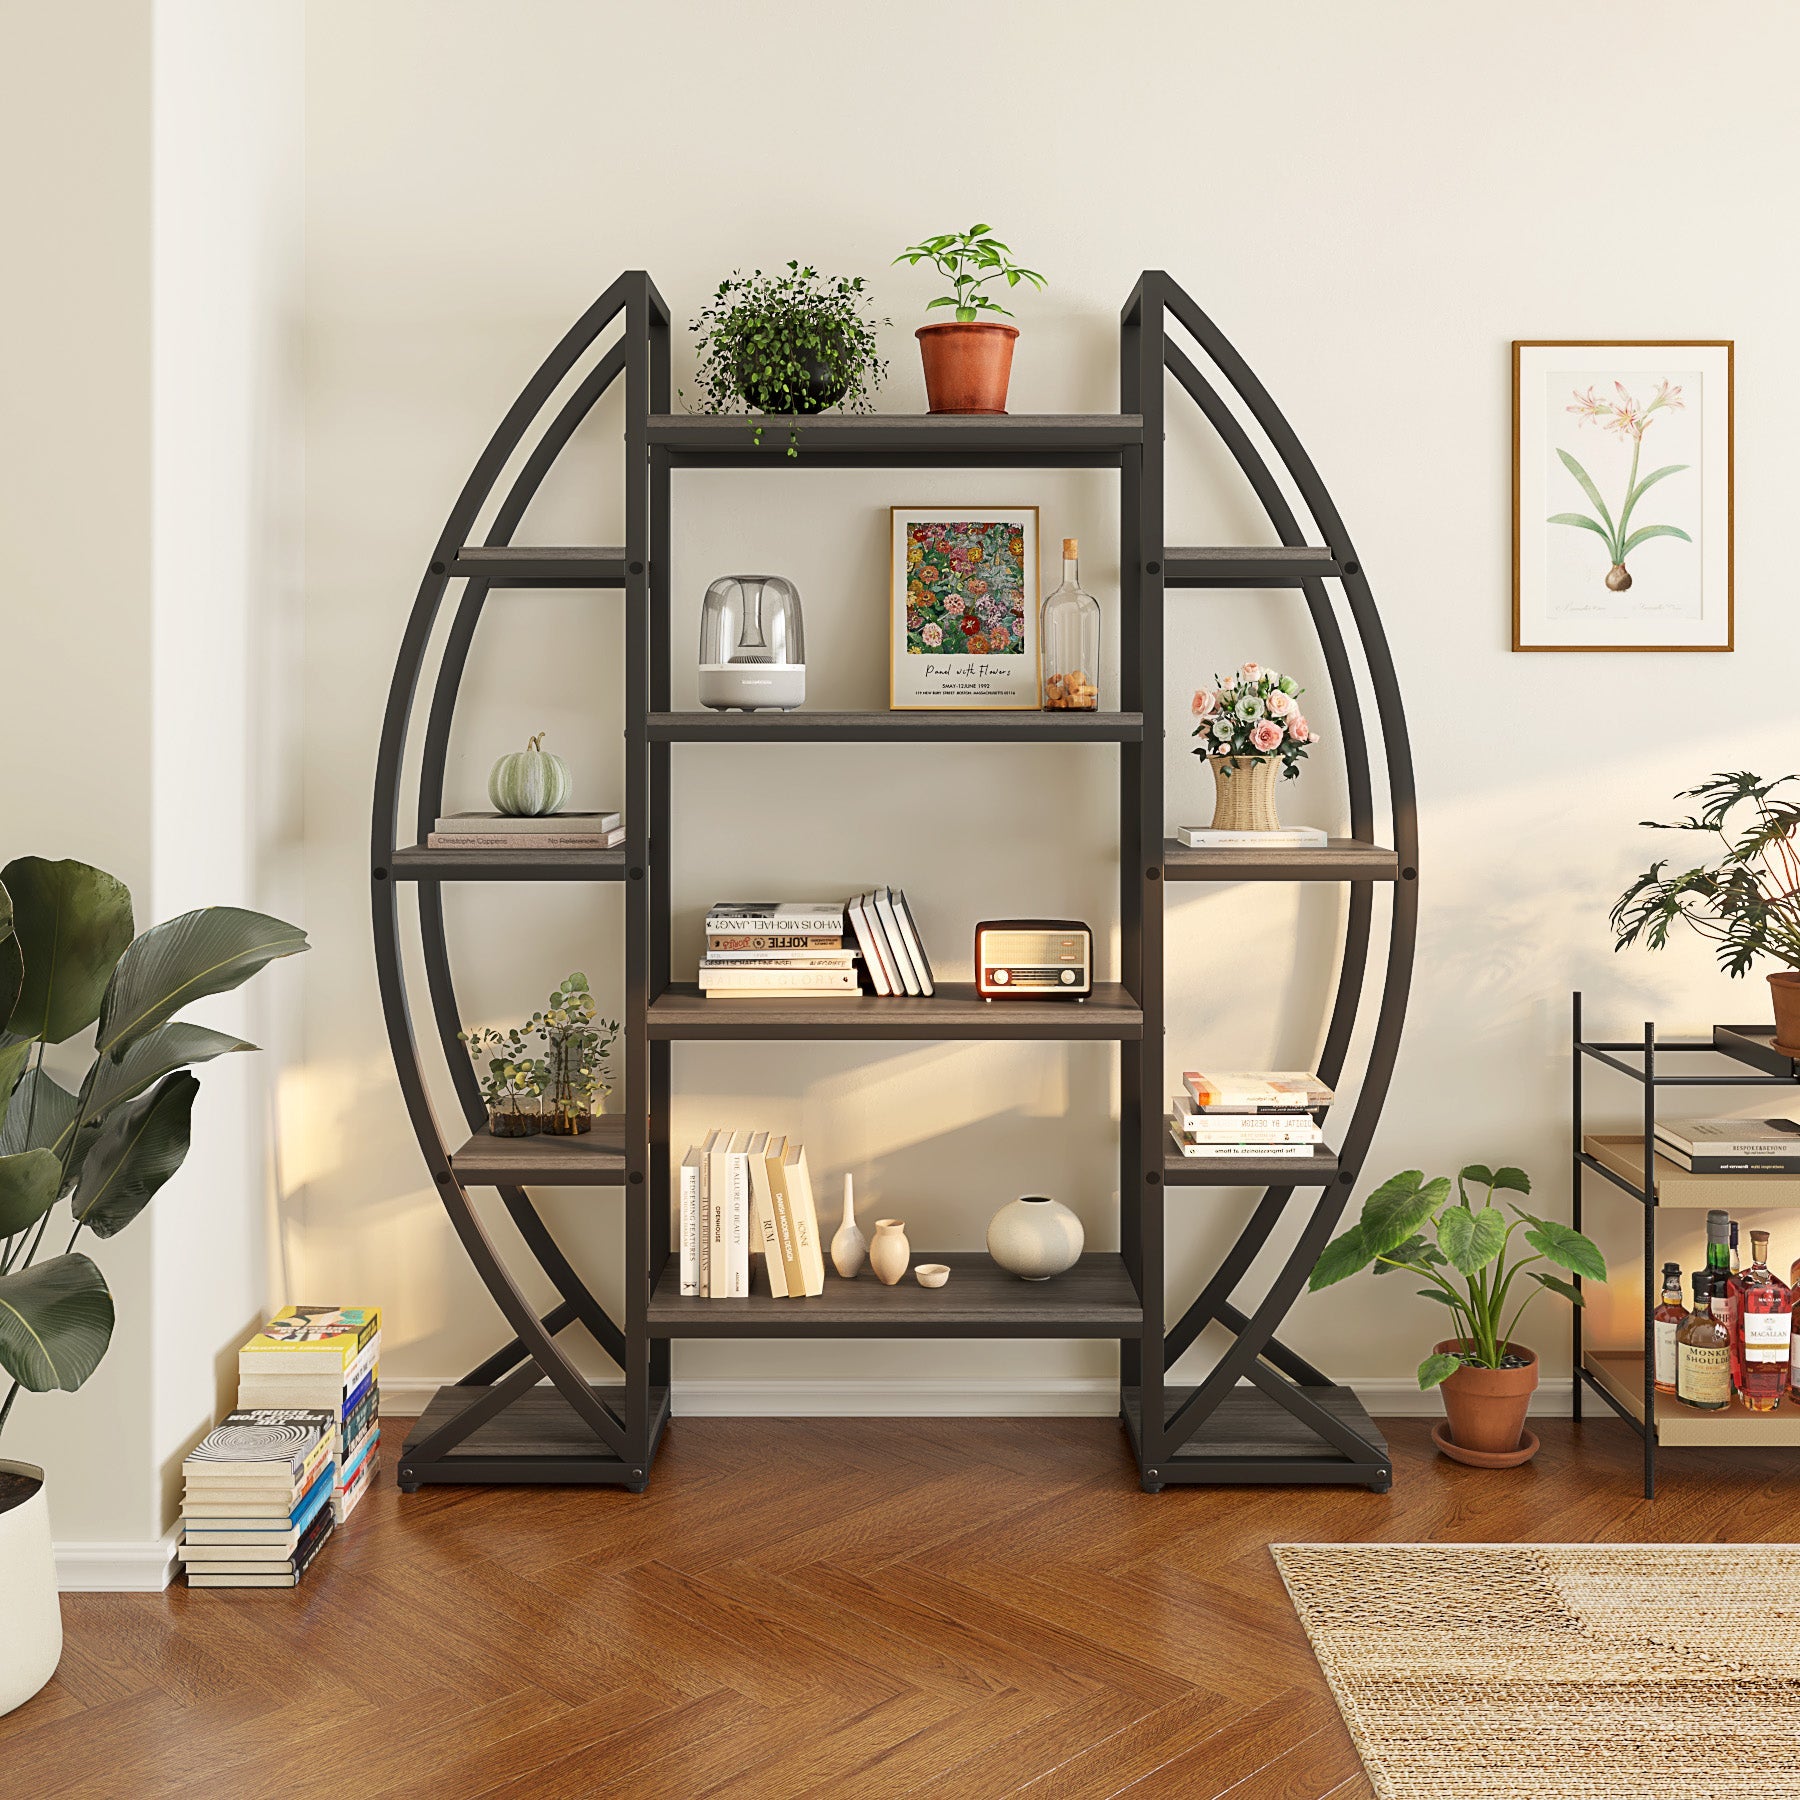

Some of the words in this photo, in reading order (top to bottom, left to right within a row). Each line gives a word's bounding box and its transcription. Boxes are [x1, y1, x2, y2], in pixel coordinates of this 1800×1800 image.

[925, 664, 952, 677] Panel
[956, 662, 976, 677] with
[979, 664, 1011, 677] Flowers
[715, 920, 750, 930] JANG?
[751, 920, 800, 930] MICHAEL
[801, 920, 812, 930] IS
[814, 920, 842, 930] WHO
[768, 936, 808, 948] KOFFIE
[734, 1203, 740, 1212] OF
[780, 1215, 790, 1240] MODERN
[784, 1240, 794, 1262] DESIGN
[1686, 1354, 1729, 1364] SHOULDE
